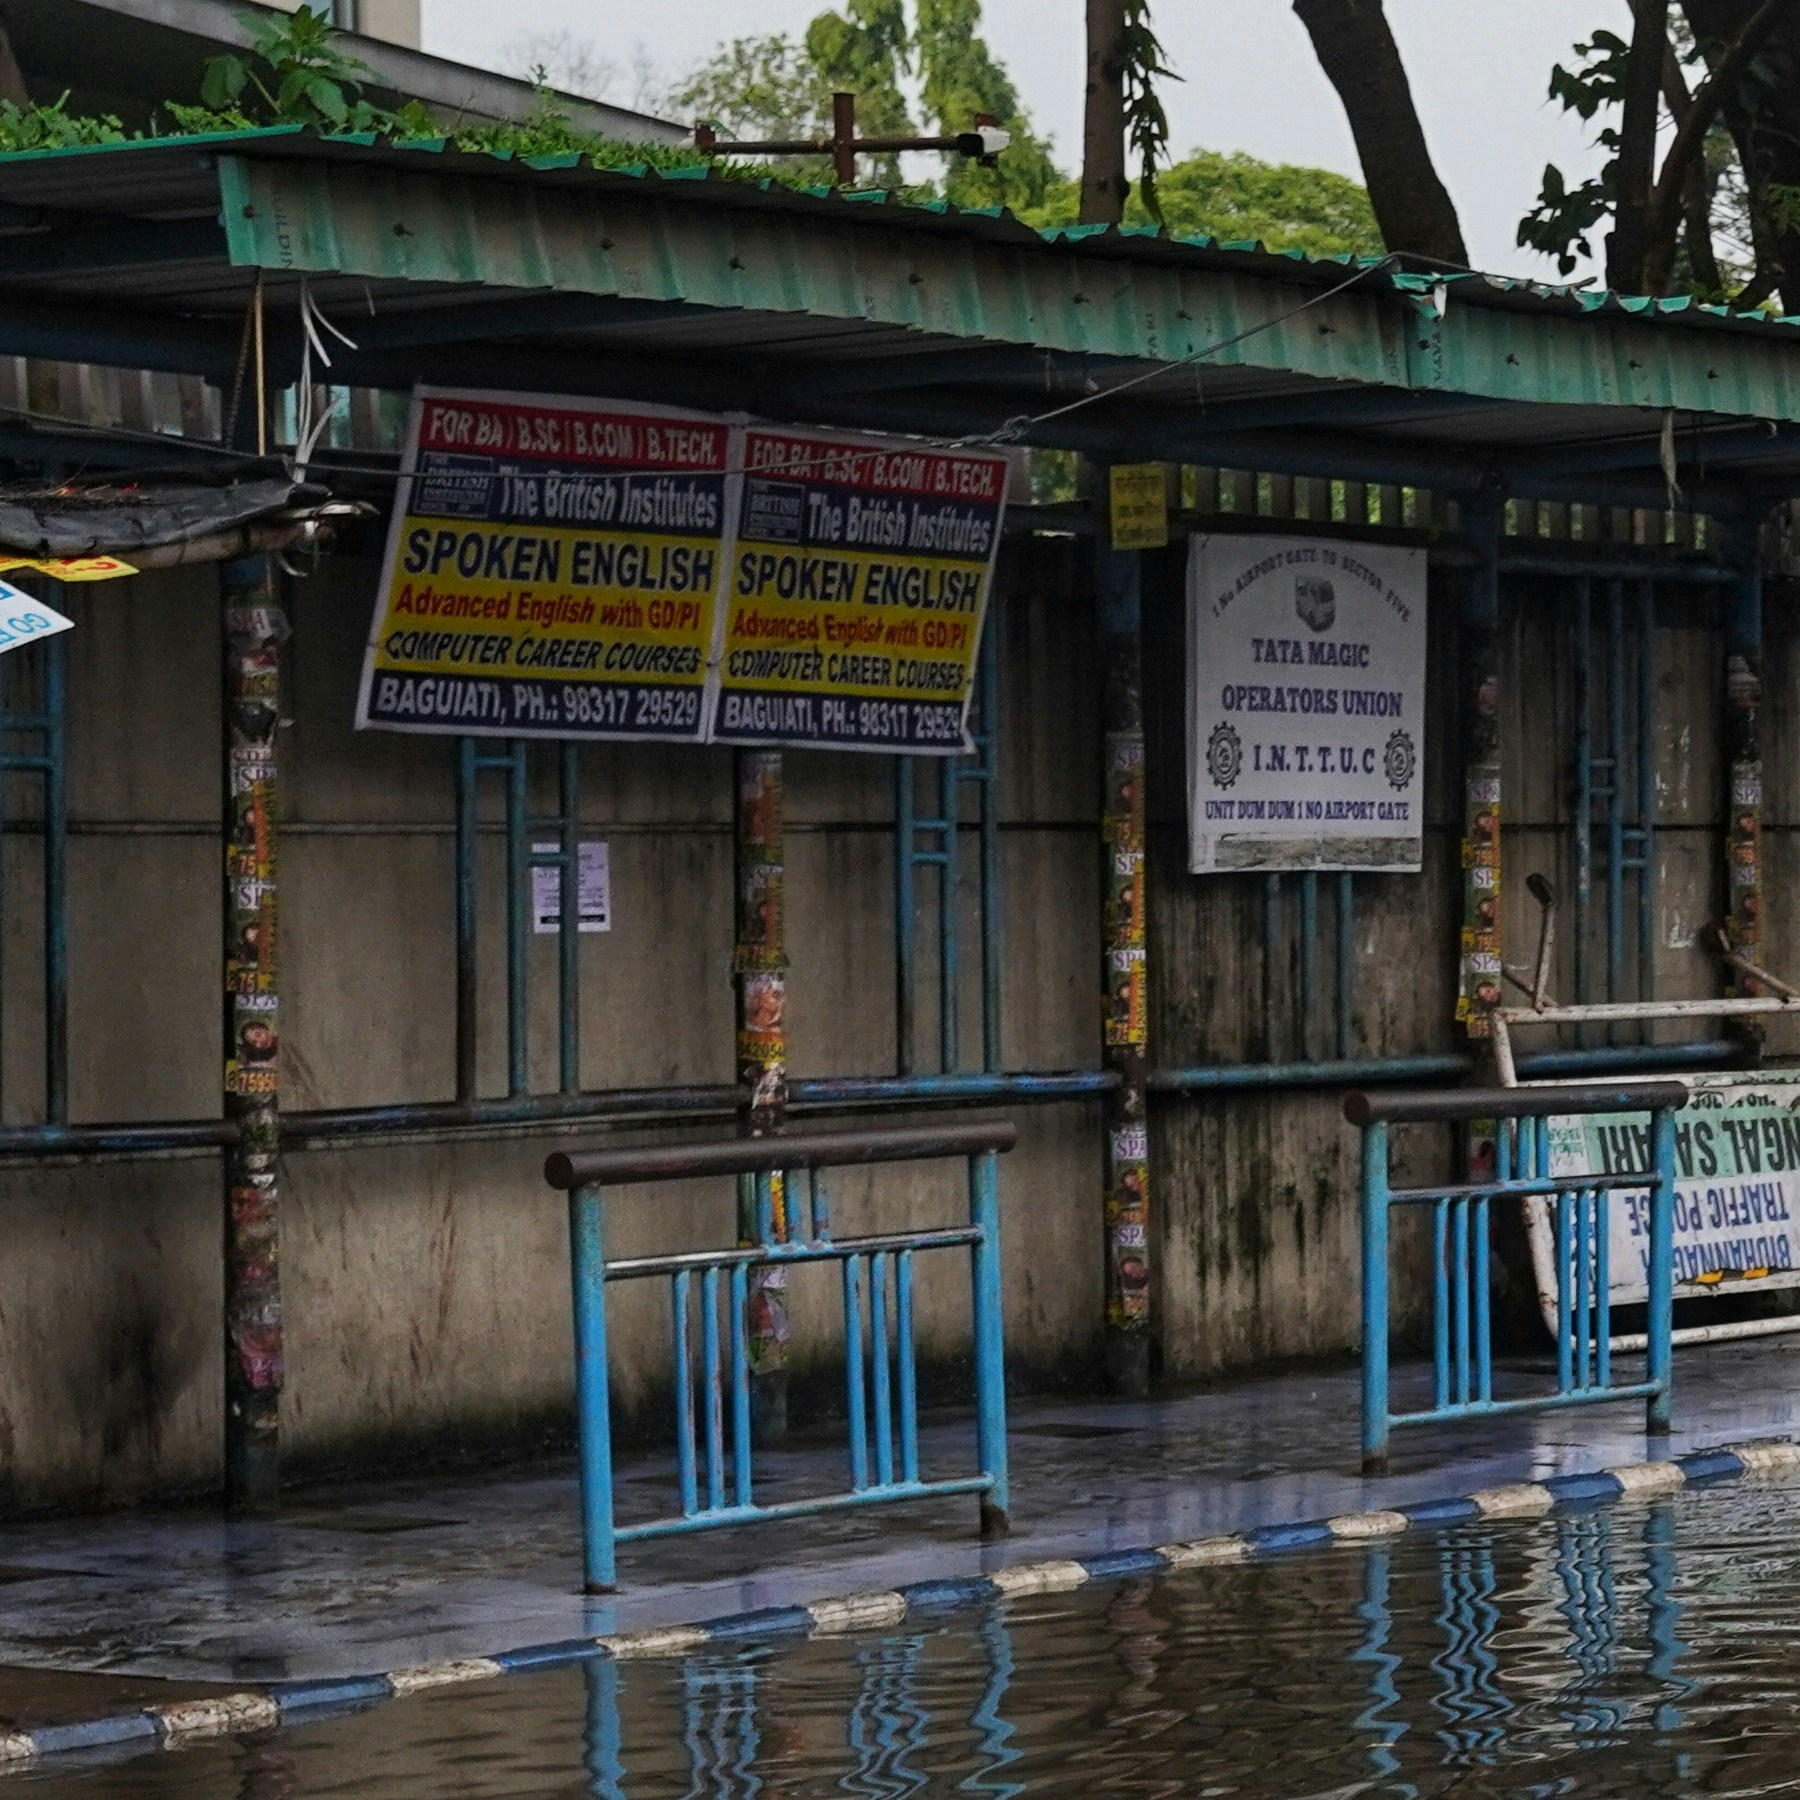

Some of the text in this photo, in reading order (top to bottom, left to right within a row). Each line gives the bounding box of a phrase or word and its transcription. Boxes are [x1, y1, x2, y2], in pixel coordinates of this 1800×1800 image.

[428, 407, 472, 443] FOR
[475, 412, 503, 448] BA
[572, 420, 633, 459] B.COM
[752, 440, 786, 474] FOR
[789, 444, 812, 478] BA
[873, 456, 927, 491] B.COM
[498, 464, 718, 529] The British Institutes
[808, 492, 991, 553] The British Institutes
[403, 528, 716, 593] SPOKEN ENGLISH
[737, 551, 982, 612] SPOKEN ENGLISH
[395, 584, 512, 619] Advanced
[516, 591, 595, 628] English
[601, 599, 643, 627] with
[733, 608, 819, 641] Advanced
[824, 614, 885, 648] English
[885, 620, 918, 647] with
[384, 630, 702, 675] COMPUTER CAREER COURSES
[728, 648, 965, 691] COMPUTER CAREER COURSES
[1252, 638, 1370, 668] TATA MAGIC
[375, 676, 507, 726] BAGUIATI,
[562, 686, 629, 725] 98317
[635, 687, 699, 727] 29529
[859, 701, 909, 738] 98317
[1221, 684, 1404, 718] OPERATORS UNION
[1237, 800, 1265, 820] DUM
[1267, 800, 1295, 820] DUM
[1305, 801, 1322, 820] NO
[1324, 801, 1375, 821] AIRPORT
[1377, 802, 1409, 821] GATE
[1598, 1120, 1718, 1178] SAARI
[1624, 1189, 1704, 1236] POCE
[1707, 1181, 1791, 1229] TRAFFIC
[1641, 1234, 1791, 1288] BIDHANNAG
